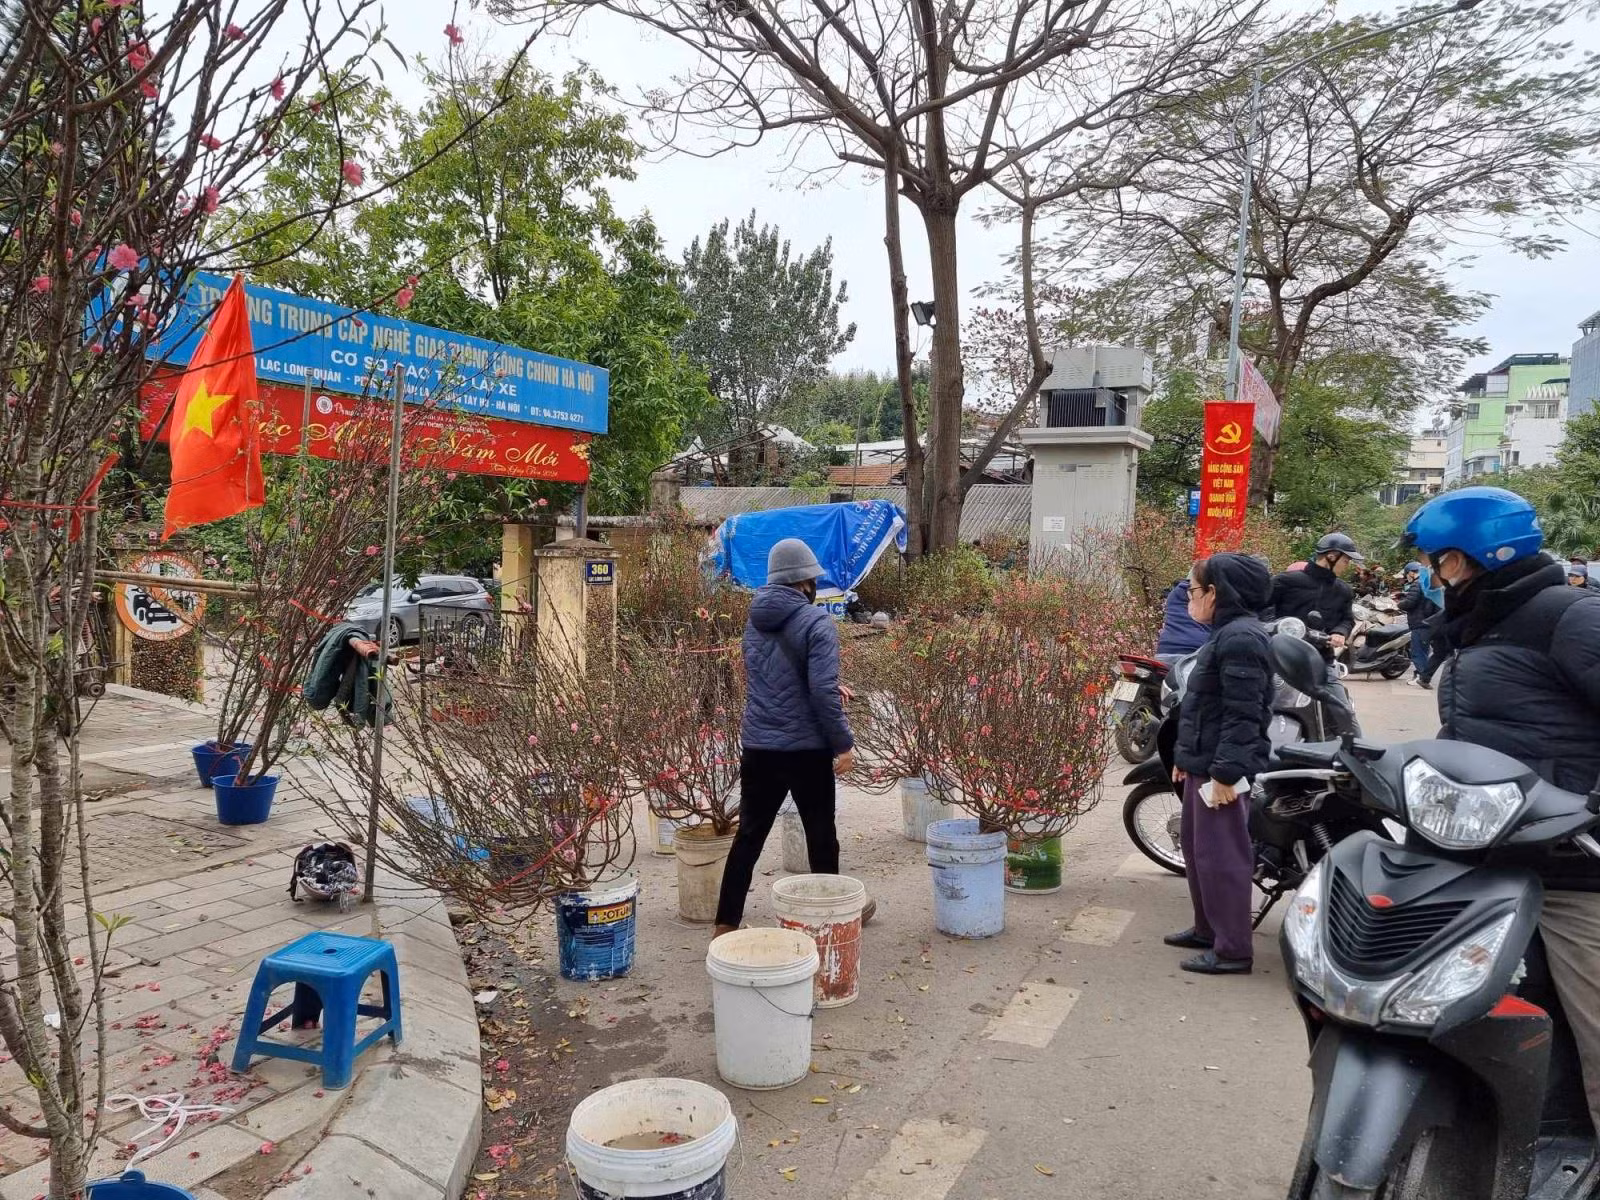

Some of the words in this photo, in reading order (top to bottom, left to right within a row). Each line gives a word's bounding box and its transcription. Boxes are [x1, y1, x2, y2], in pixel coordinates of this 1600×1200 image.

[198, 283, 273, 326] TRNG
[278, 303, 333, 338] TRUNG
[415, 335, 446, 361] GIAO
[526, 359, 559, 386] CHÍNH
[561, 365, 576, 390] HÀ
[577, 369, 595, 396] NỘI
[330, 349, 358, 367] CƠ
[394, 361, 430, 381] ÀO
[498, 381, 518, 397] XE
[505, 441, 560, 467] Mới
